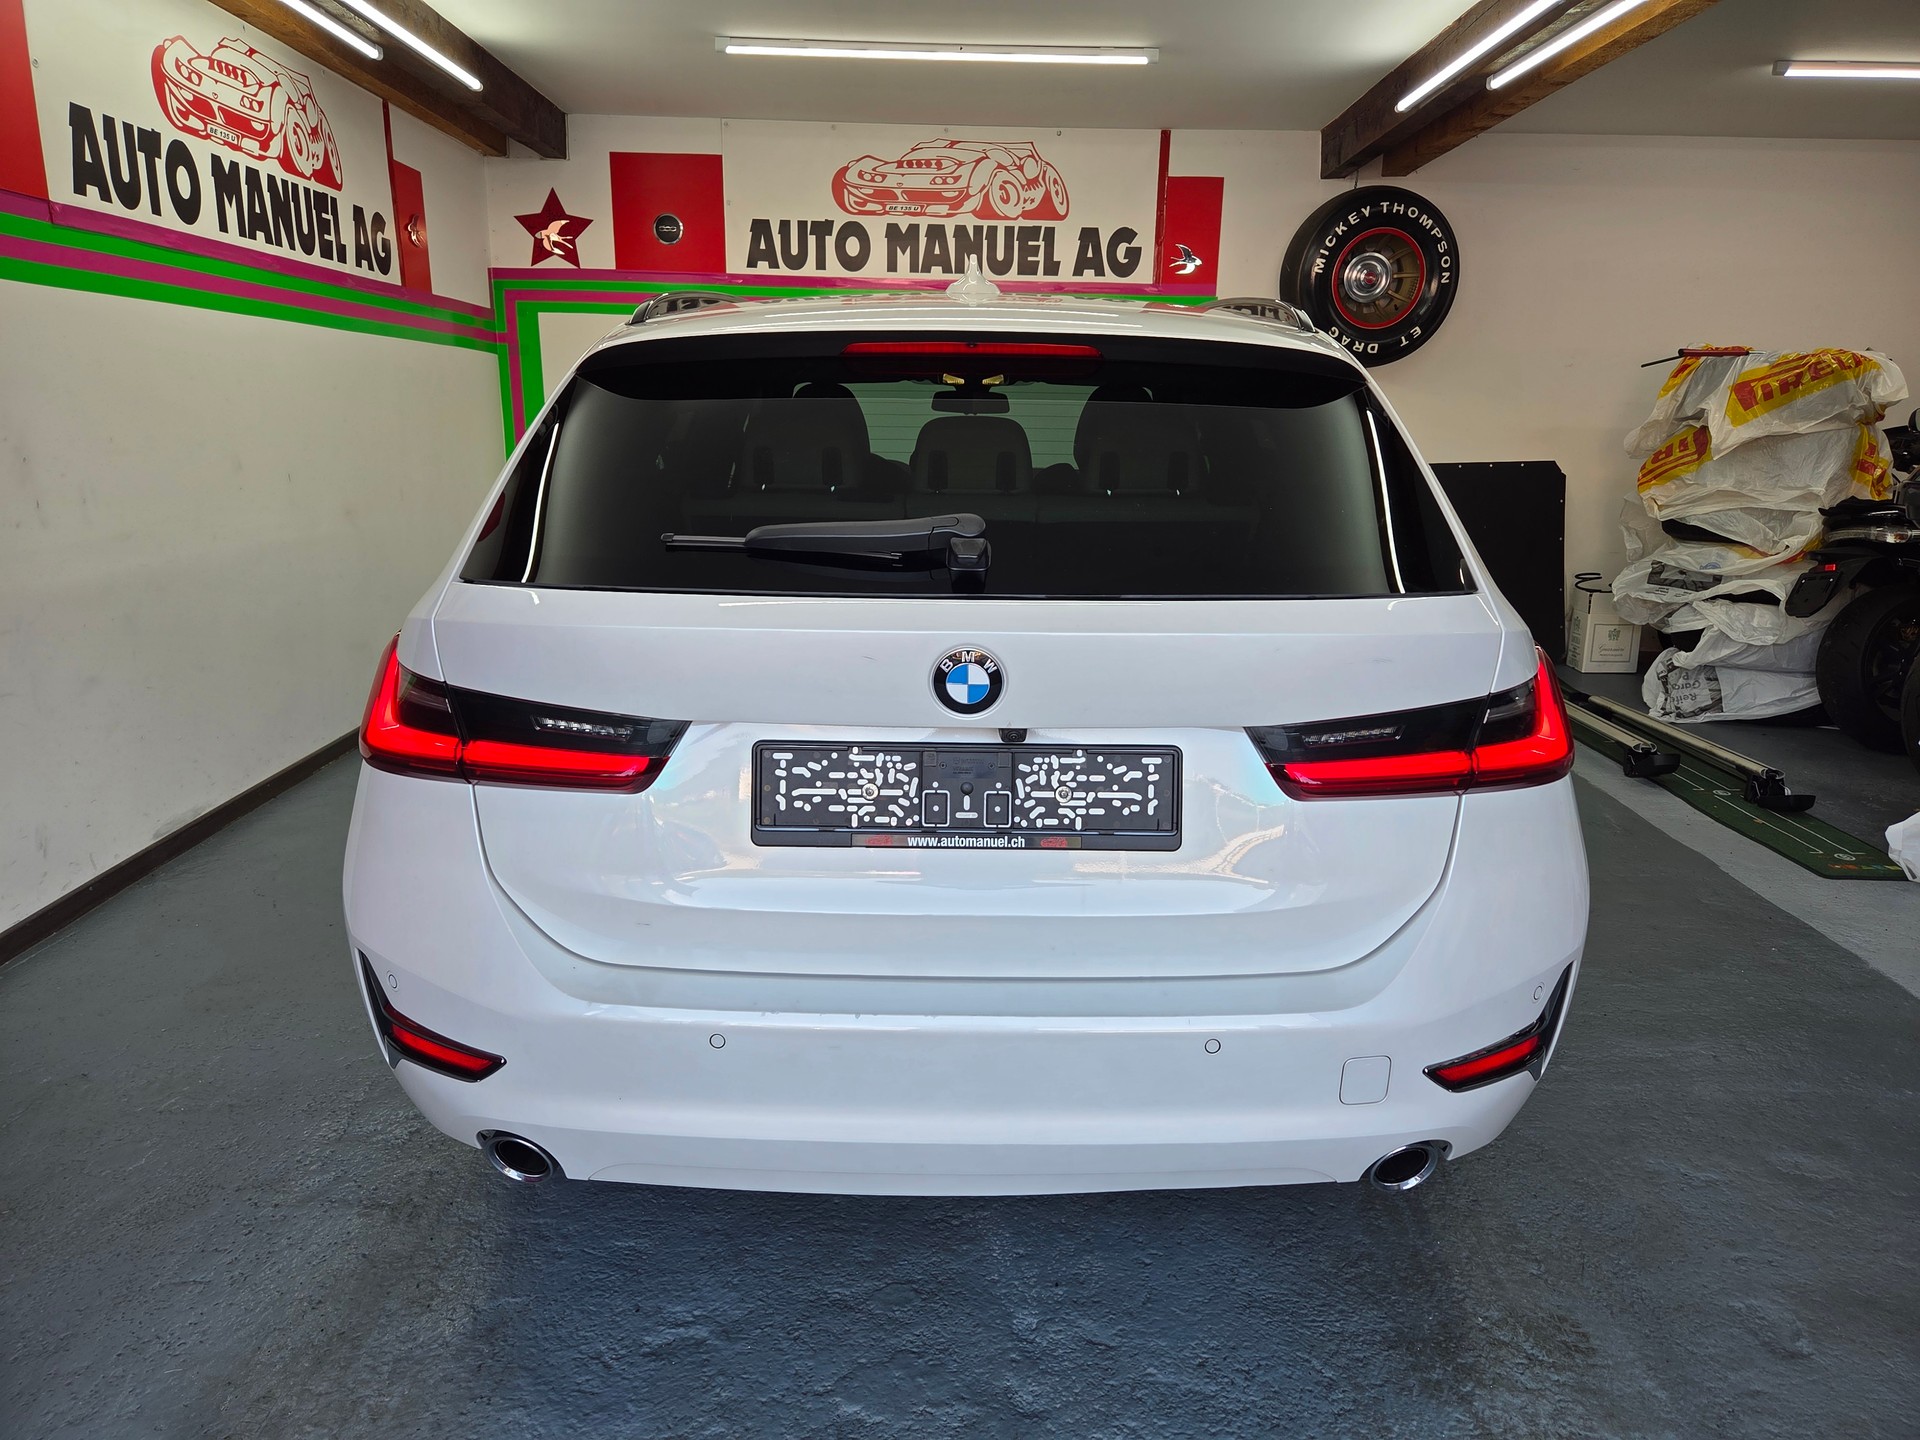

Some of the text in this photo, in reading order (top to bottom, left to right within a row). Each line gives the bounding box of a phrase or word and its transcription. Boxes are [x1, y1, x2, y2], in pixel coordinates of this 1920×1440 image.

[209, 127, 218, 135] BE
[220, 131, 230, 139] 135
[69, 101, 391, 276] AUTO MANUEL AG
[746, 218, 1142, 279] AUTO MANUEL AG
[1314, 202, 1451, 284] MICKEY THOMPSON
[1328, 326, 1422, 354] ET DRAG
[939, 650, 998, 674] BMW
[907, 835, 1026, 848] www.automanuel.ch
